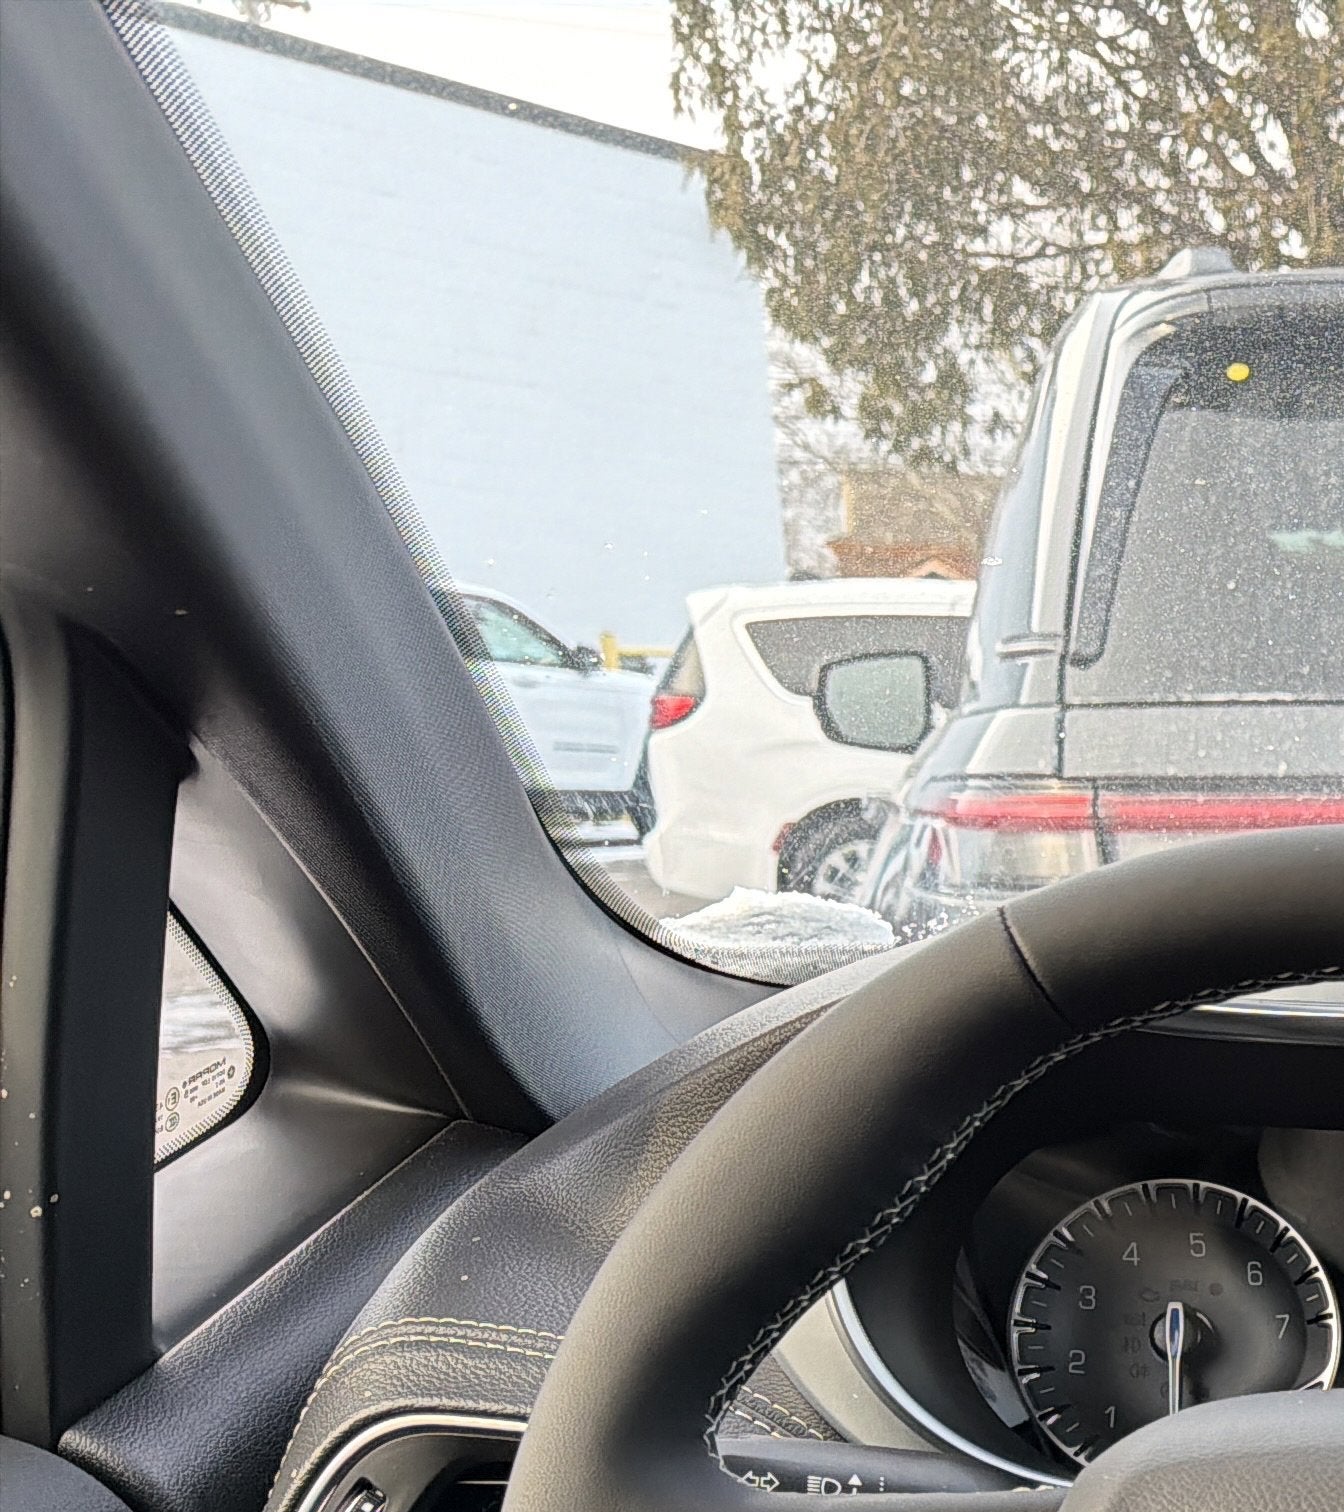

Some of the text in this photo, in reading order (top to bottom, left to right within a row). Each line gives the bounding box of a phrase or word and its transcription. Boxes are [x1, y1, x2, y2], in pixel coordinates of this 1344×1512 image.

[1122, 1242, 1140, 1266] 4
[1189, 1232, 1206, 1257] 5
[1247, 1261, 1264, 1286] 6
[1079, 1285, 1096, 1310] 3
[1275, 1314, 1290, 1339] 7
[1068, 1349, 1086, 1375] 2
[1104, 1405, 1115, 1428] 1
